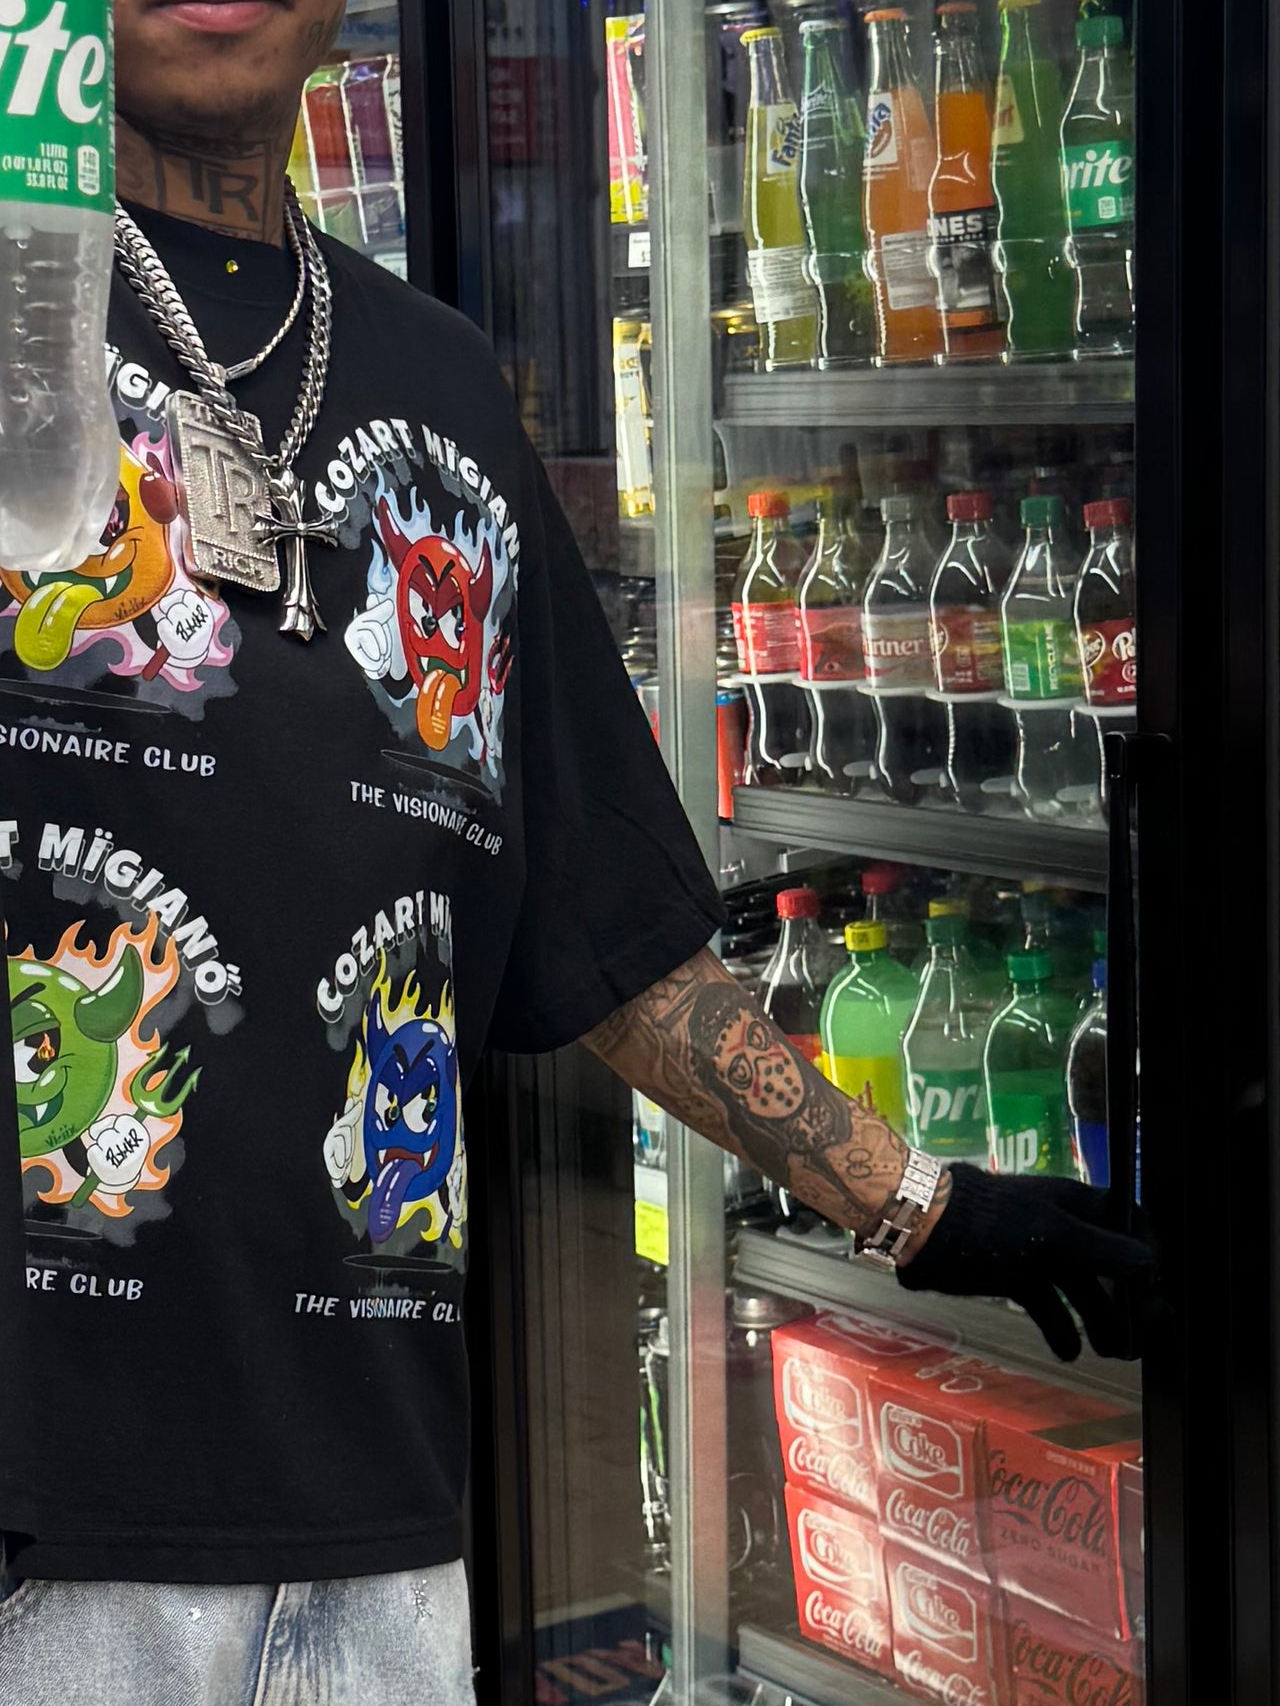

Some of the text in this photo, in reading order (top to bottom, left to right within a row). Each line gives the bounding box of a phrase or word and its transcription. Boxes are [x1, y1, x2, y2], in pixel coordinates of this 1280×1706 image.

[315, 417, 415, 515] COZART
[143, 745, 217, 778] CLUB
[349, 781, 504, 856] THE CLUB
[316, 889, 426, 1024] COZART
[69, 1272, 145, 1301] CLUB
[293, 1293, 337, 1317] THE
[895, 1421, 947, 1468] Coke
[885, 1488, 973, 1559] Coca-Cola
[804, 1592, 886, 1662] Coca-Cola
